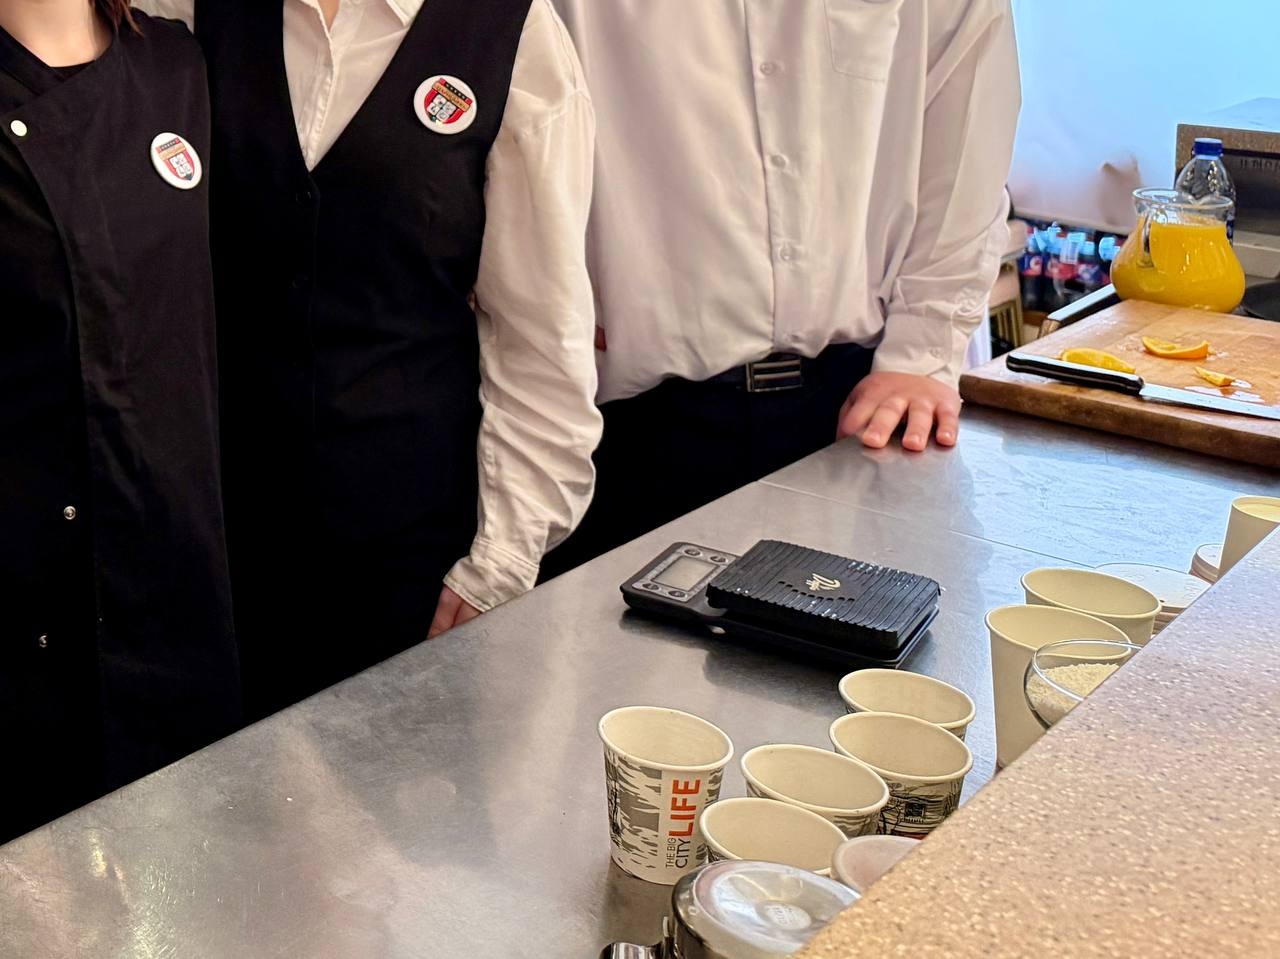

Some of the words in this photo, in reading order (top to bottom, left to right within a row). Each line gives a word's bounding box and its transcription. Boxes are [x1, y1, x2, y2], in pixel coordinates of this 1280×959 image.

[668, 779, 701, 836] LIFE
[665, 854, 675, 869] THE
[675, 838, 691, 869] CITY
